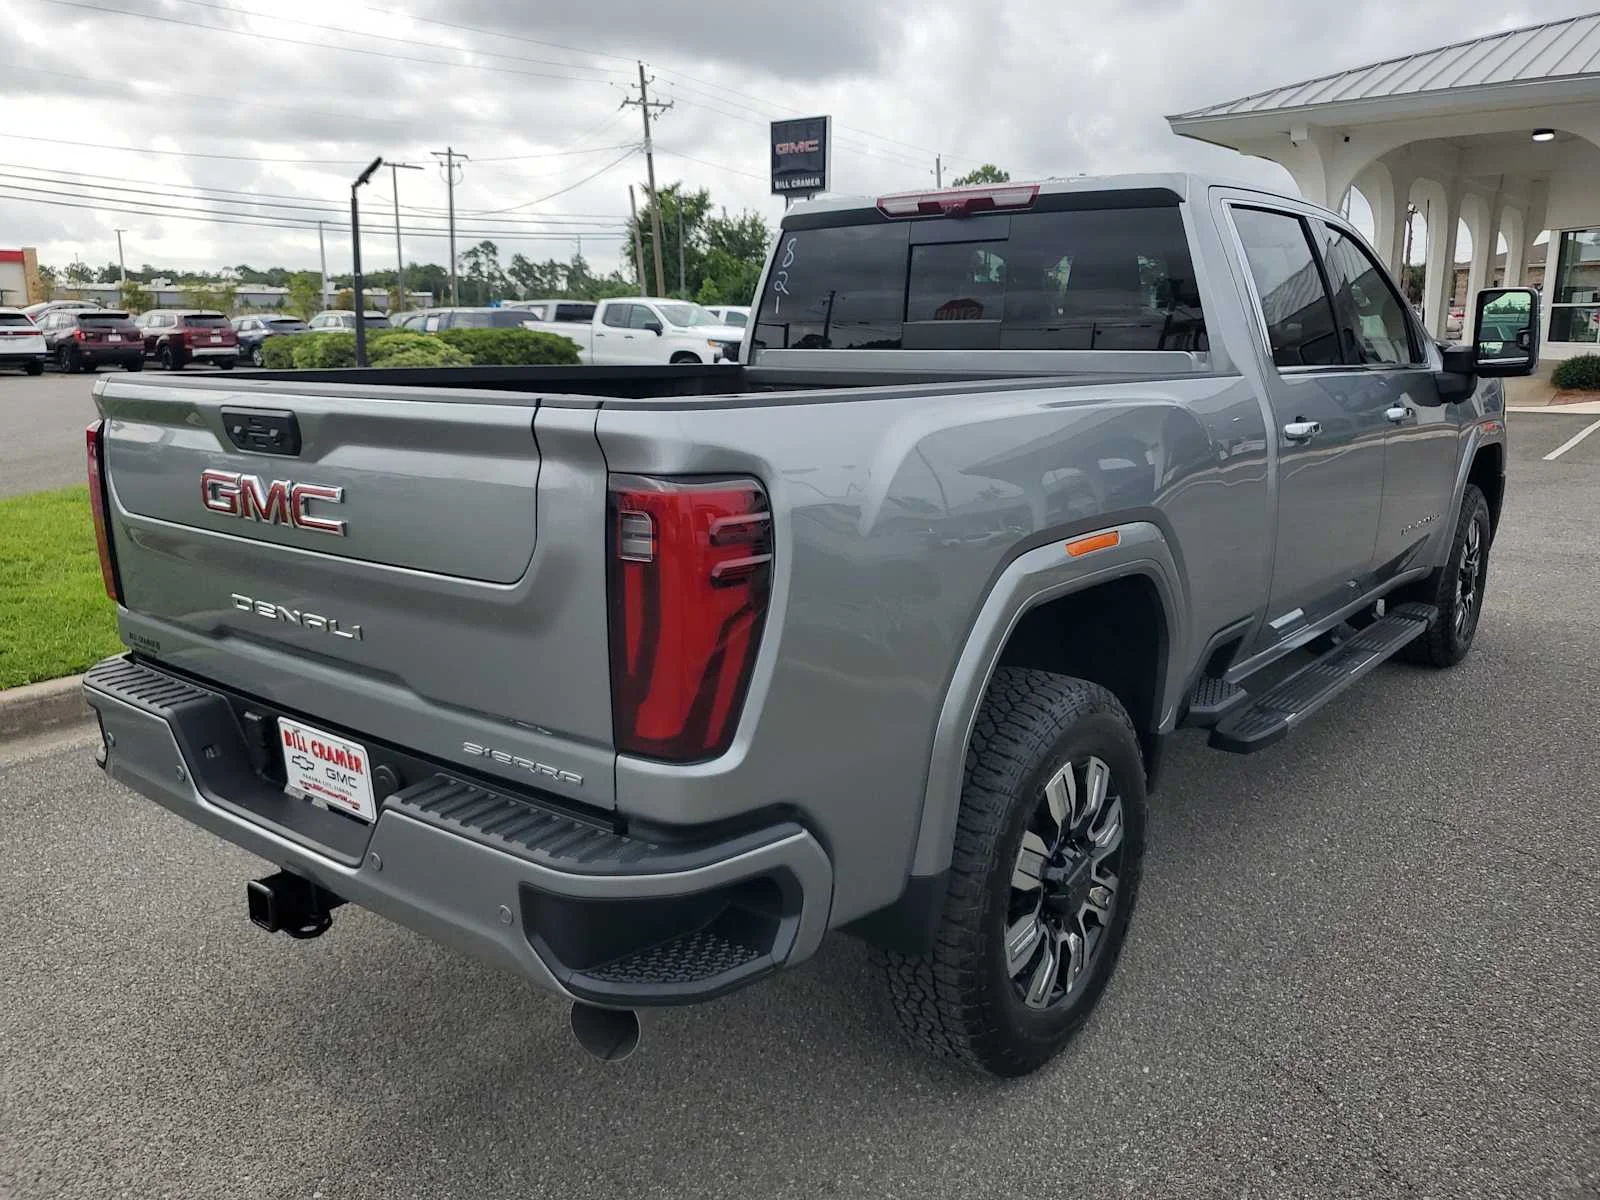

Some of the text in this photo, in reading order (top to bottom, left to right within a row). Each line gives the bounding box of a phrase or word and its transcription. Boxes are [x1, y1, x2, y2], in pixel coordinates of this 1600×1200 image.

[776, 140, 818, 155] GMC
[775, 177, 821, 189] BILL CRAMER
[201, 468, 348, 537] GMC
[231, 593, 363, 640] DENALI
[283, 729, 363, 775] BILL CRAMER
[463, 741, 584, 785] SIERRA
[326, 767, 358, 789] GMC
